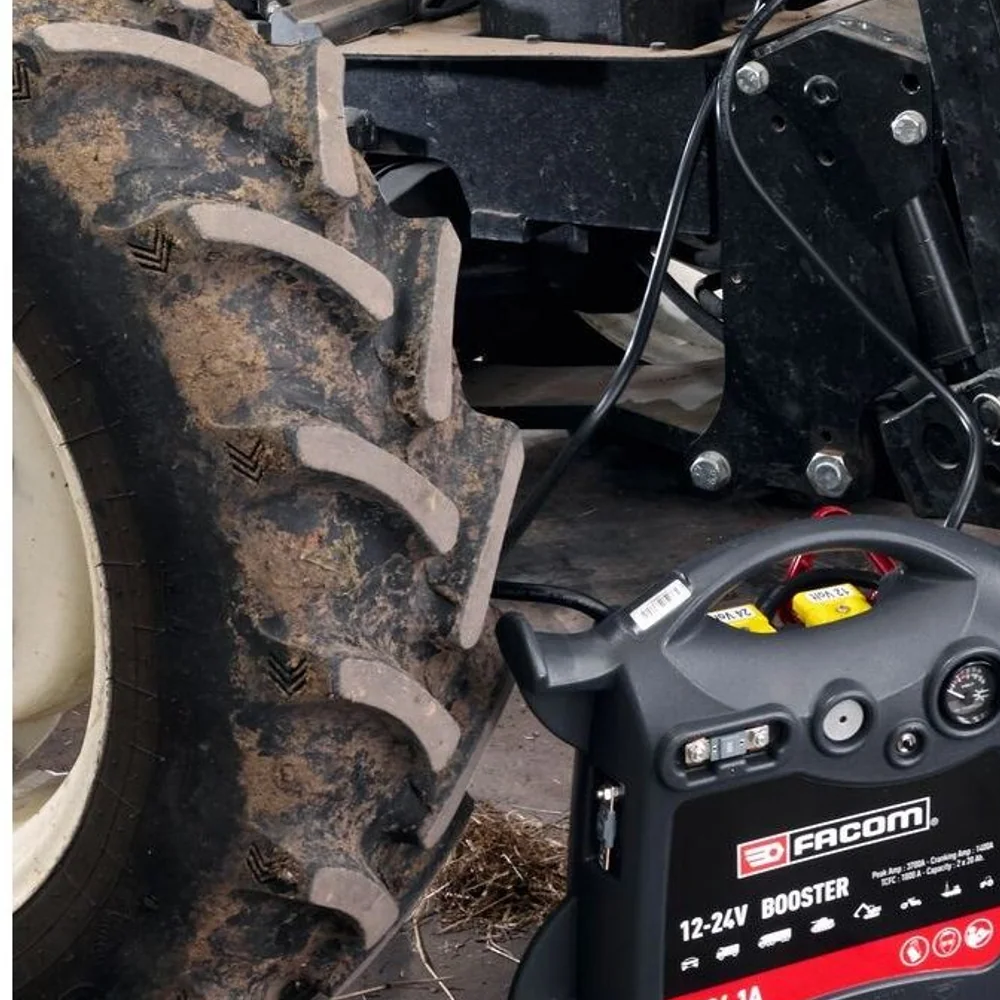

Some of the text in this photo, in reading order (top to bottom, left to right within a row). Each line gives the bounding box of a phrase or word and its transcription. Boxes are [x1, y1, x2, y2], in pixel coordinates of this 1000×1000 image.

[794, 806, 924, 856] FACOM
[680, 876, 850, 942] 12-24V BOOSTER
